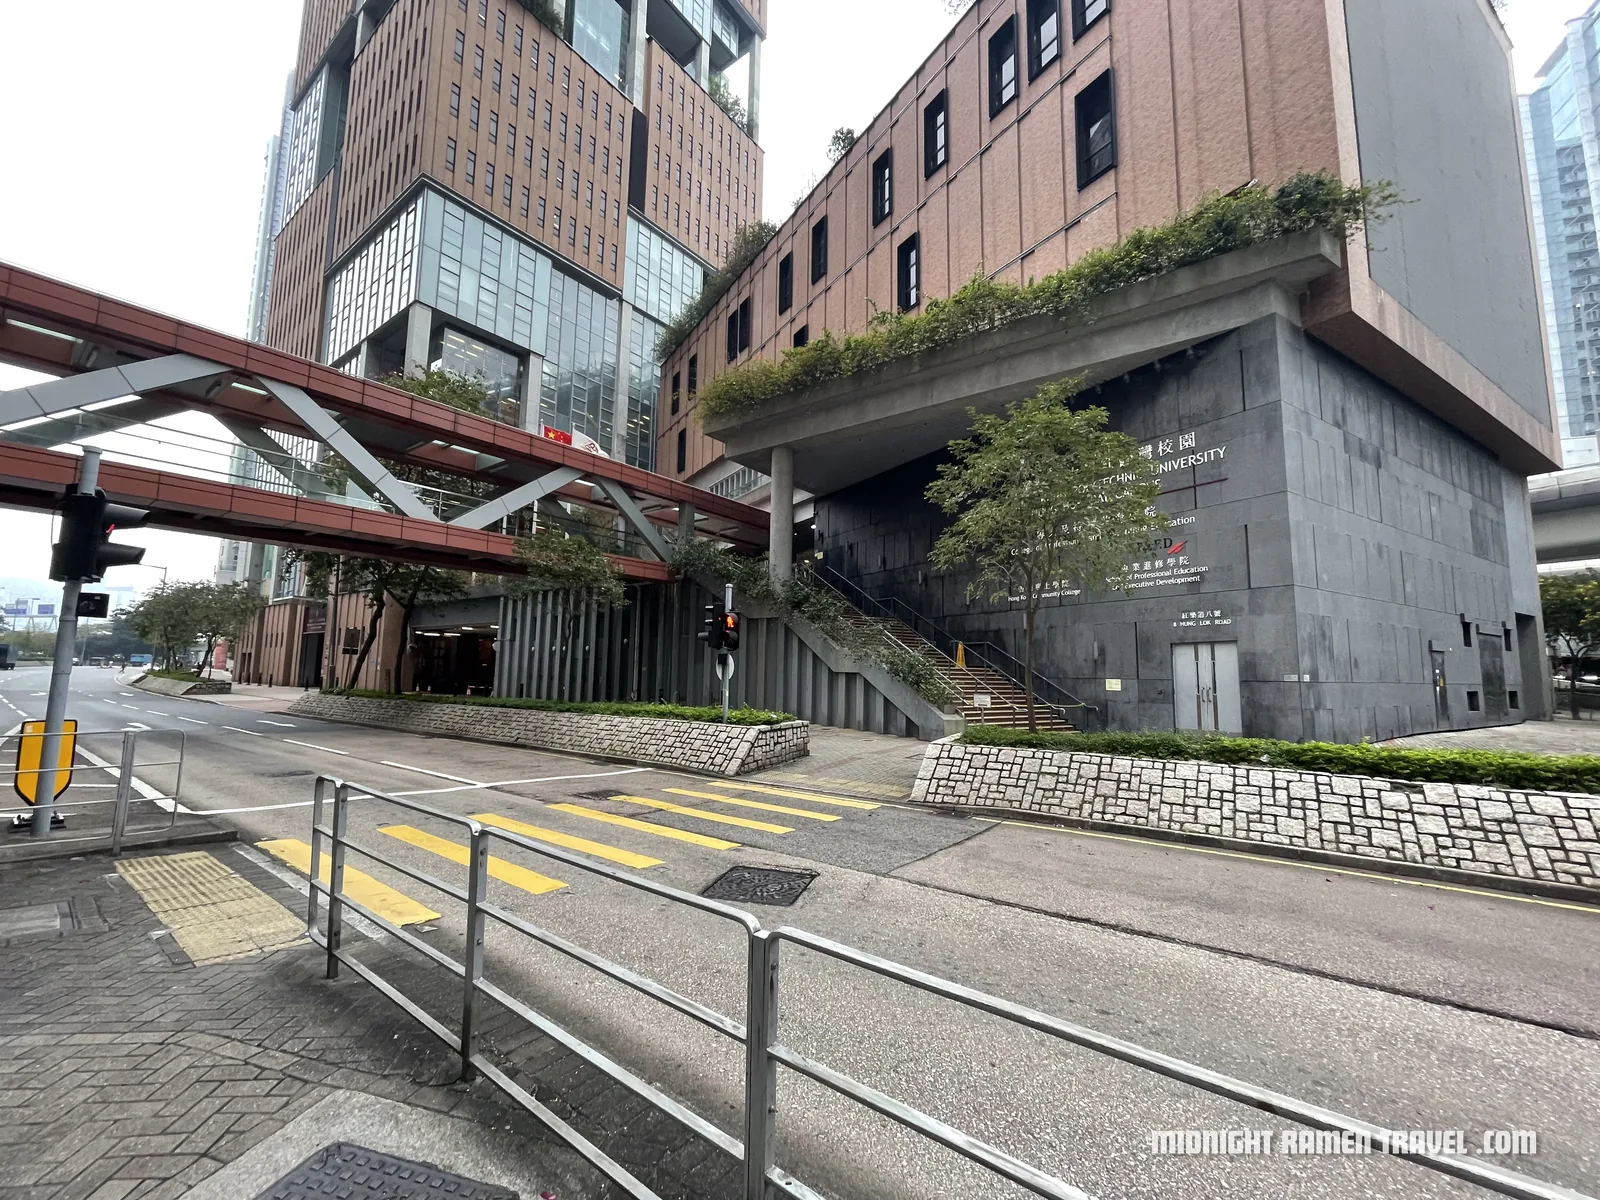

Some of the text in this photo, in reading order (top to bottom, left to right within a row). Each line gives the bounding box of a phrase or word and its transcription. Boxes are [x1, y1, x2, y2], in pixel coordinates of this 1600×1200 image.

[1134, 569, 1172, 580] Professional
[1173, 565, 1209, 576] Education
[1156, 575, 1201, 587] Development
[1061, 588, 1082, 597] College
